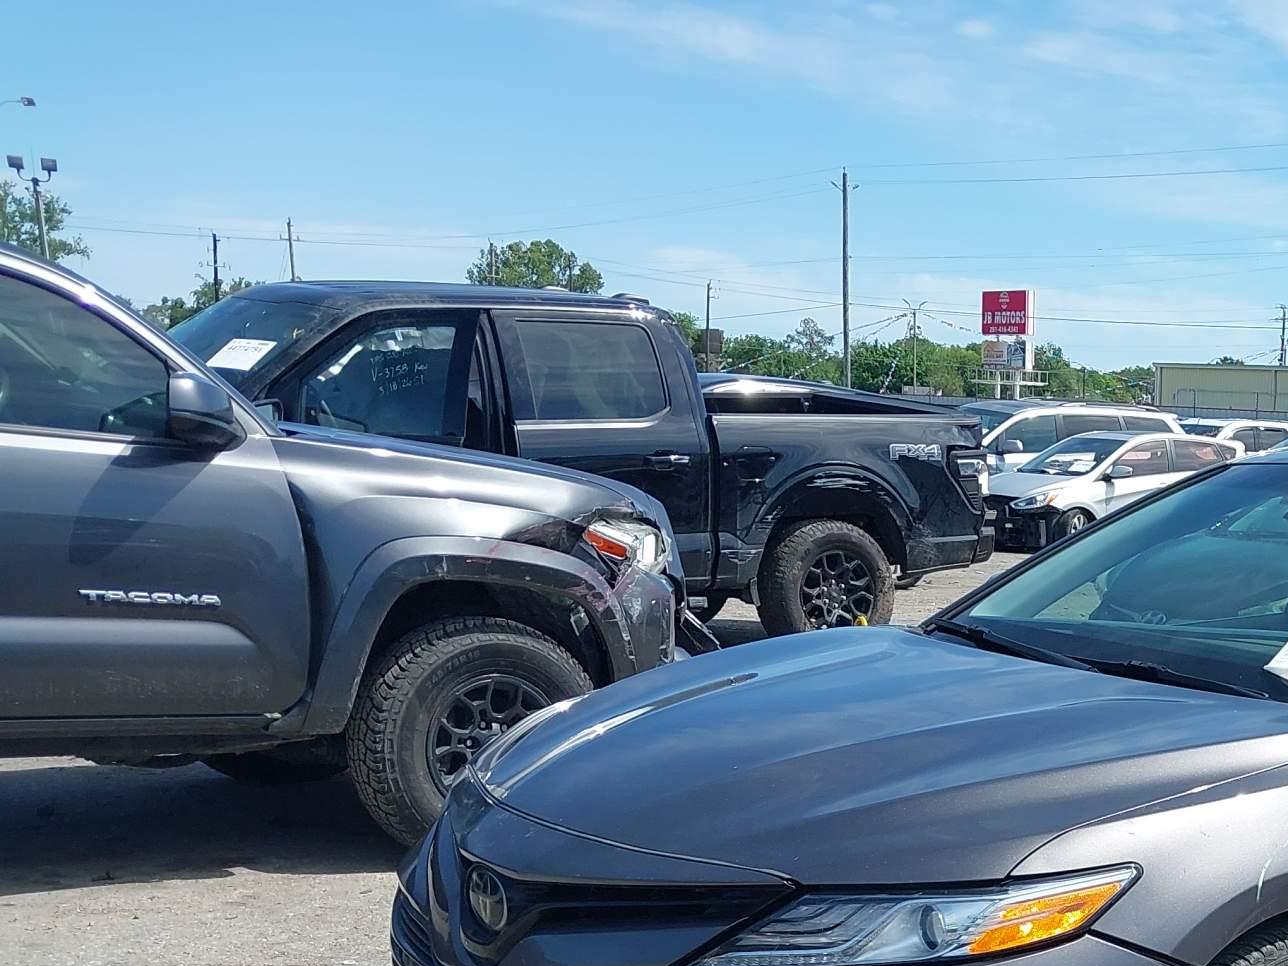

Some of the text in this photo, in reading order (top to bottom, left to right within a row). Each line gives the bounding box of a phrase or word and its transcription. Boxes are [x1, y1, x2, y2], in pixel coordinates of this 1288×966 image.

[983, 311, 1025, 324] JB MOTORS
[889, 443, 942, 461] FX4
[78, 589, 222, 606] TACOMA
